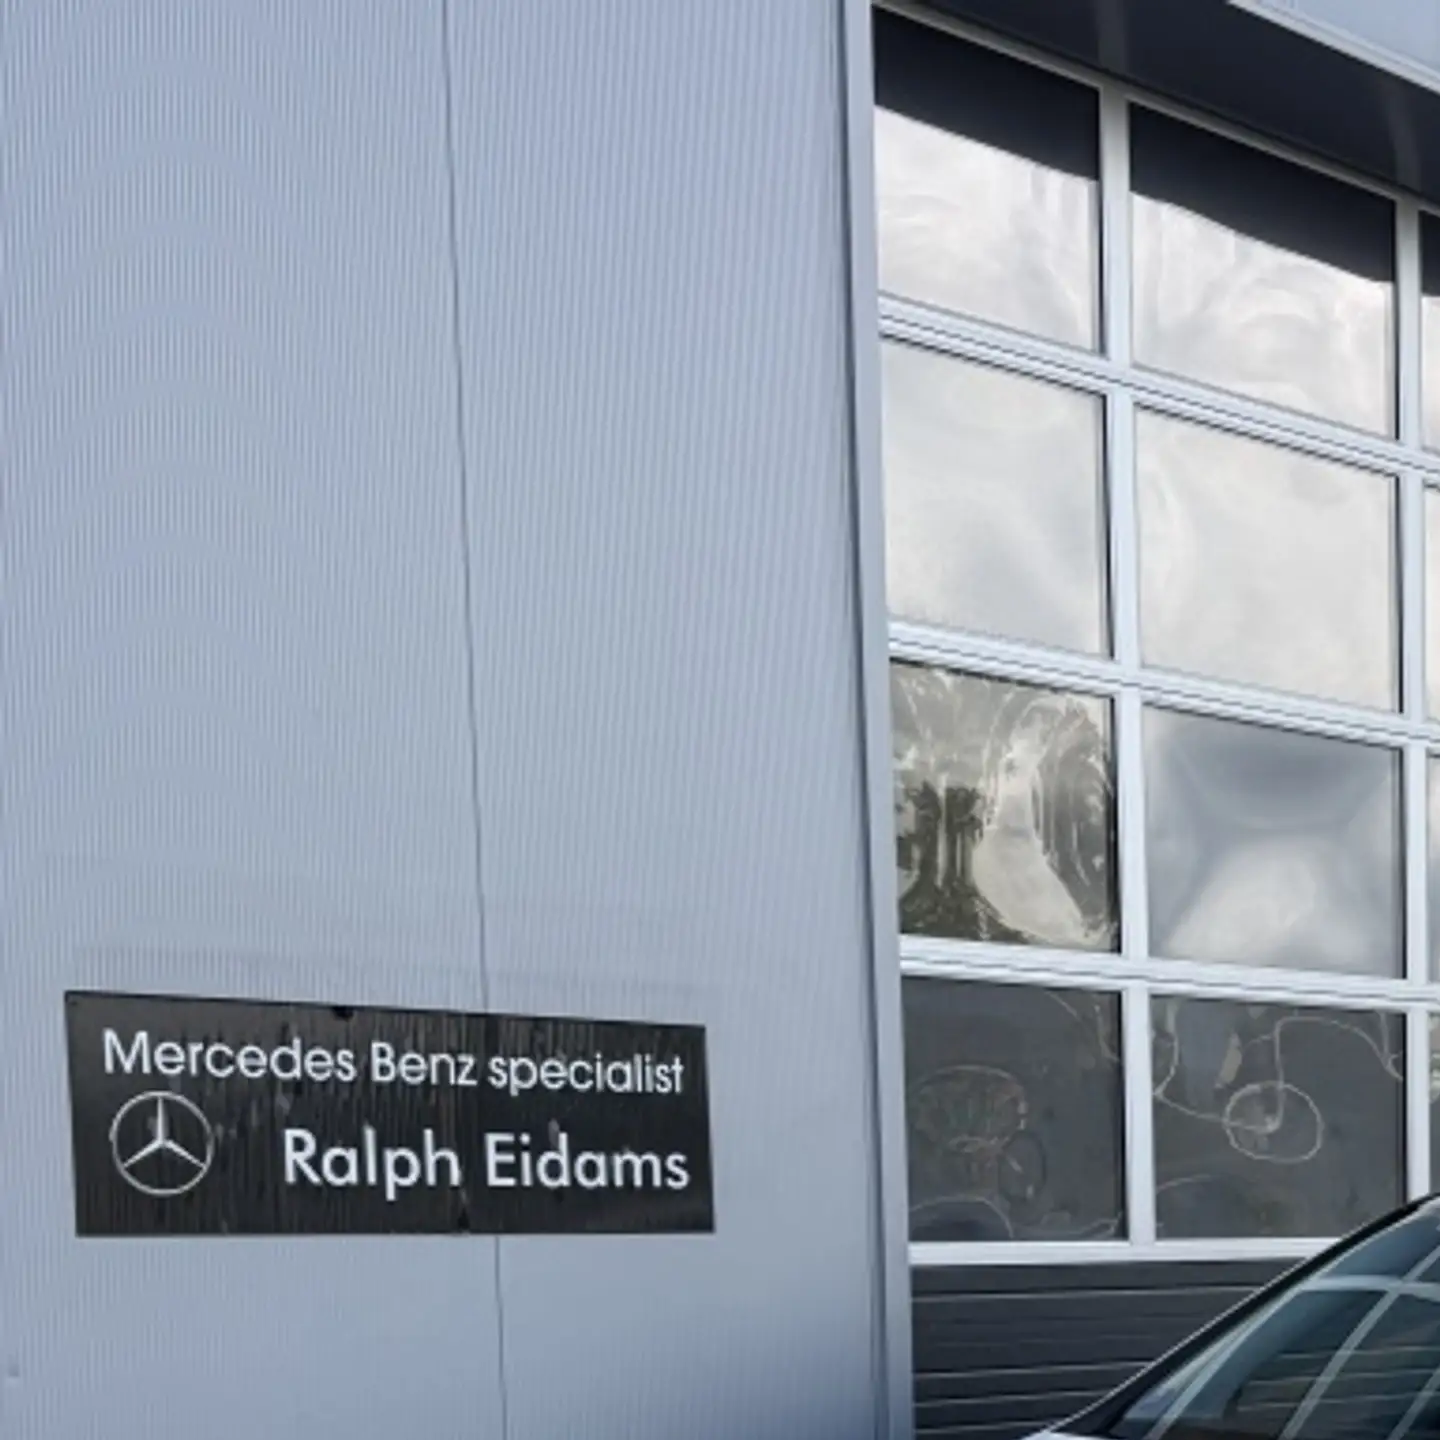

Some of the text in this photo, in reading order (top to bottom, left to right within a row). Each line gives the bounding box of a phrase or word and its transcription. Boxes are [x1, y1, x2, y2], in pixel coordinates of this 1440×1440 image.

[103, 1029, 684, 1096] Mercedes Benz specialist
[284, 1125, 690, 1200] Ralph Eidams
